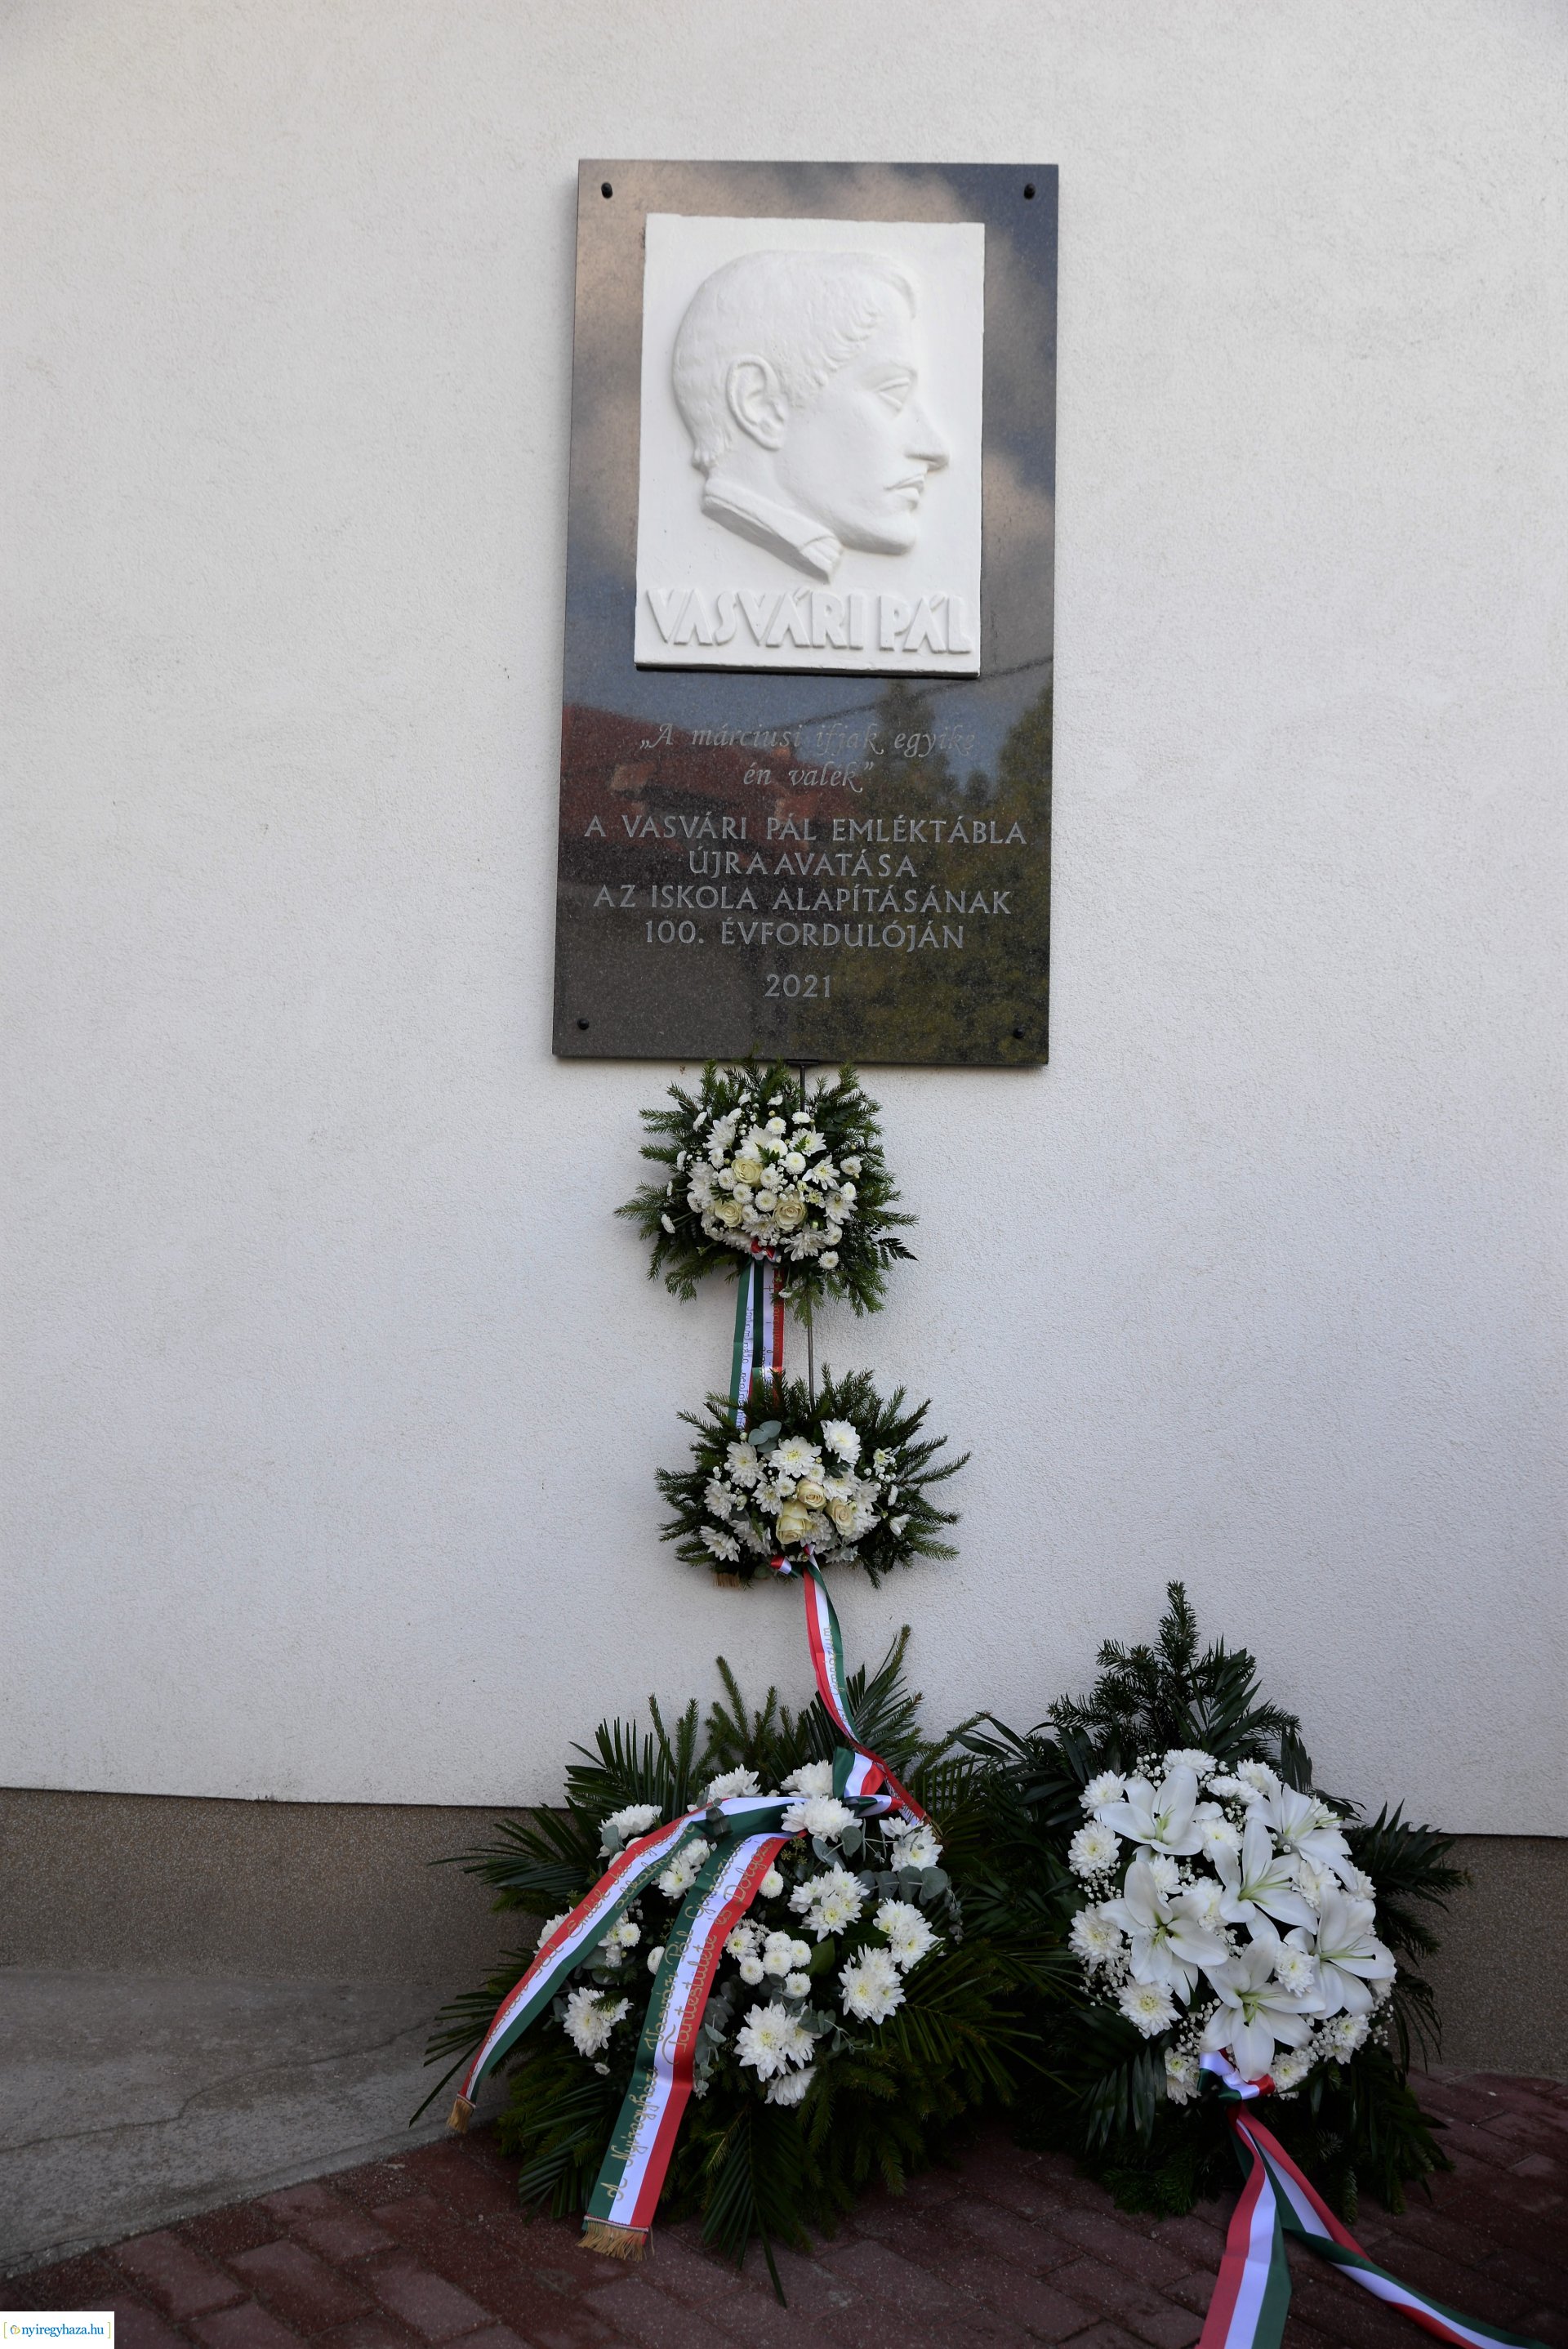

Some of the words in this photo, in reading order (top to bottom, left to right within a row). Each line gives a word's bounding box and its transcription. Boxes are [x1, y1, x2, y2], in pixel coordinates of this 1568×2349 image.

[646, 587, 864, 650] VASVÁRI
[878, 590, 973, 654] PÁL
[691, 724, 801, 749] márciusi
[817, 723, 884, 756] ifjak
[893, 728, 977, 758] egyike
[743, 763, 773, 786] én
[584, 817, 606, 838] A
[622, 813, 747, 840] VASVÁRI
[766, 815, 817, 841] PÁL
[833, 814, 1027, 845] EMLÉKTÁBLA
[690, 846, 918, 877] ÚJRAAVATÁSA
[594, 885, 636, 907] AZ
[650, 885, 759, 910] ISKOLA
[772, 885, 1011, 915] ALAPÍTÁSÁNAK
[645, 920, 704, 944] 100.
[720, 919, 964, 952] ÉVFORDULÓJÁN
[764, 974, 831, 998] 2021
[664, 1929, 693, 1965] Pál
